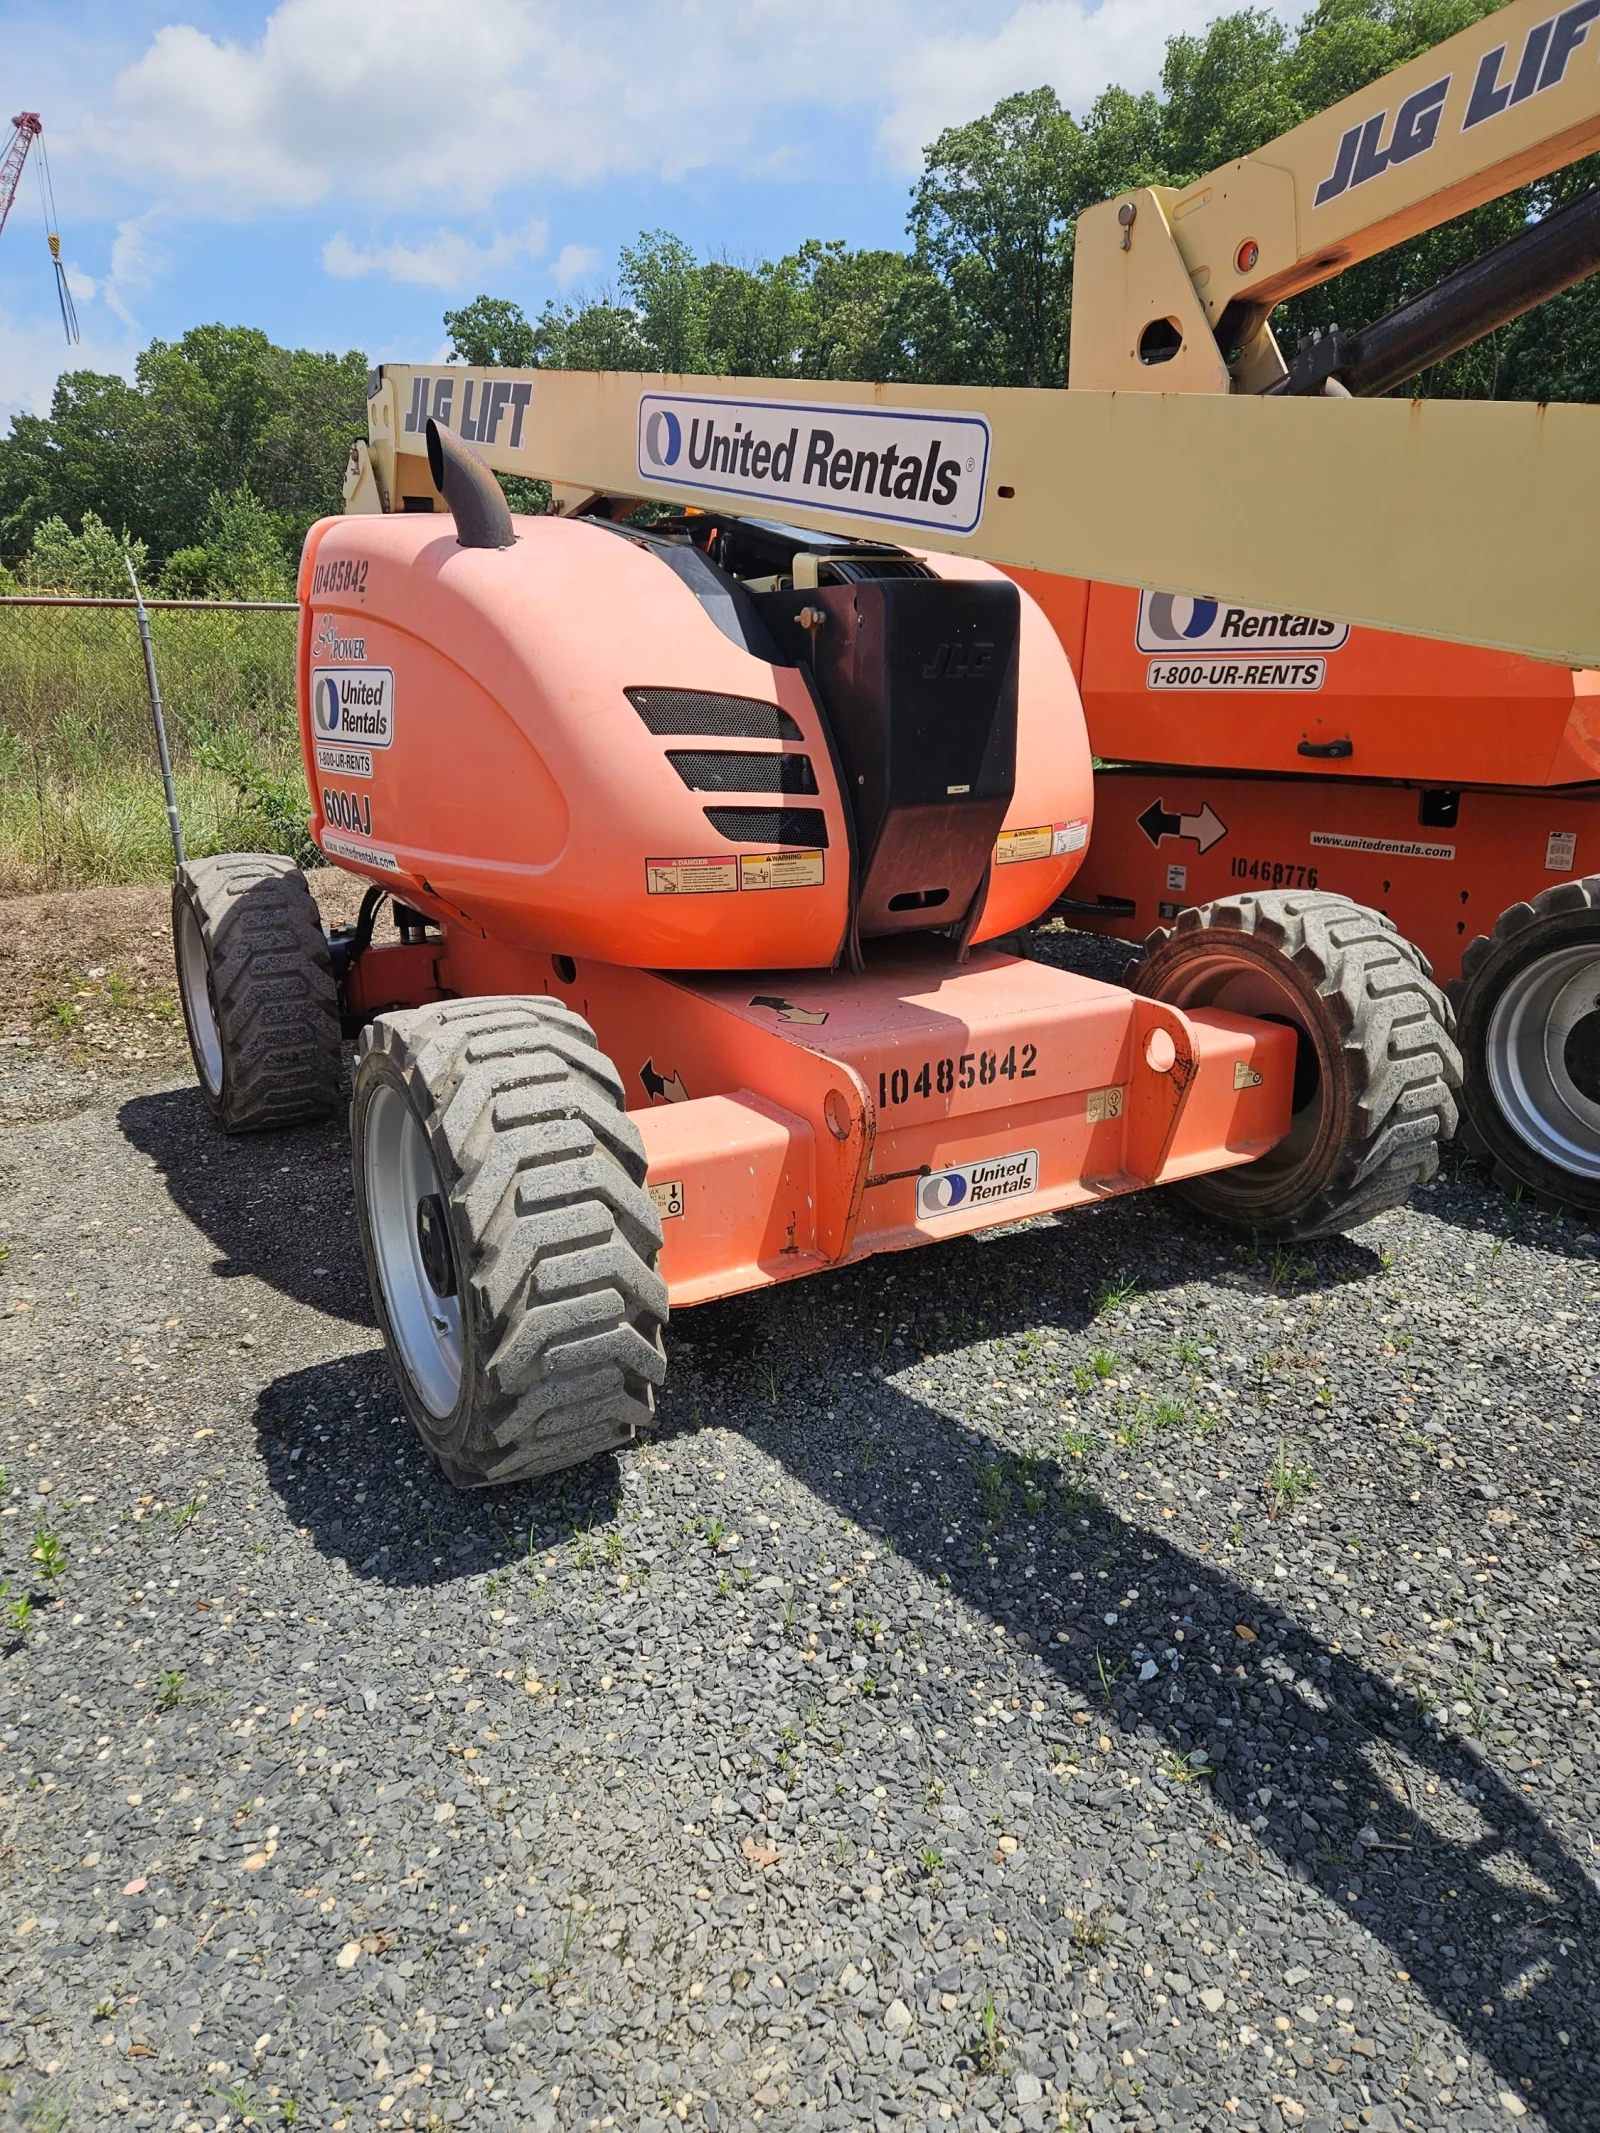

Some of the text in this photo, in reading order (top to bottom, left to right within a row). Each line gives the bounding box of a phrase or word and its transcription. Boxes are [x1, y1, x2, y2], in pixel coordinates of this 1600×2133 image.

[1312, 0, 1600, 208] JLG LIF
[404, 377, 533, 448] JLG LIFT
[688, 418, 961, 506] United Rentals
[312, 560, 369, 595] 10485842
[1220, 609, 1335, 638] Rentals
[332, 639, 365, 660] POWER
[1152, 664, 1319, 686] 1-800-UR-RENTS
[341, 679, 385, 706] United
[341, 707, 387, 736] Rentals
[318, 750, 370, 772] 1-800-UR-RENTS
[323, 787, 373, 836] 600AJ
[1018, 829, 1039, 837] WARNING
[1312, 835, 1452, 858] www.unitedrentals.com
[325, 841, 397, 868] www.unitedrentals.com
[772, 853, 802, 861] WARNING
[1231, 856, 1319, 890] 10468776
[879, 1043, 1037, 1108] 10485842
[971, 1158, 1028, 1185] United
[970, 1175, 1032, 1202] Rentals
